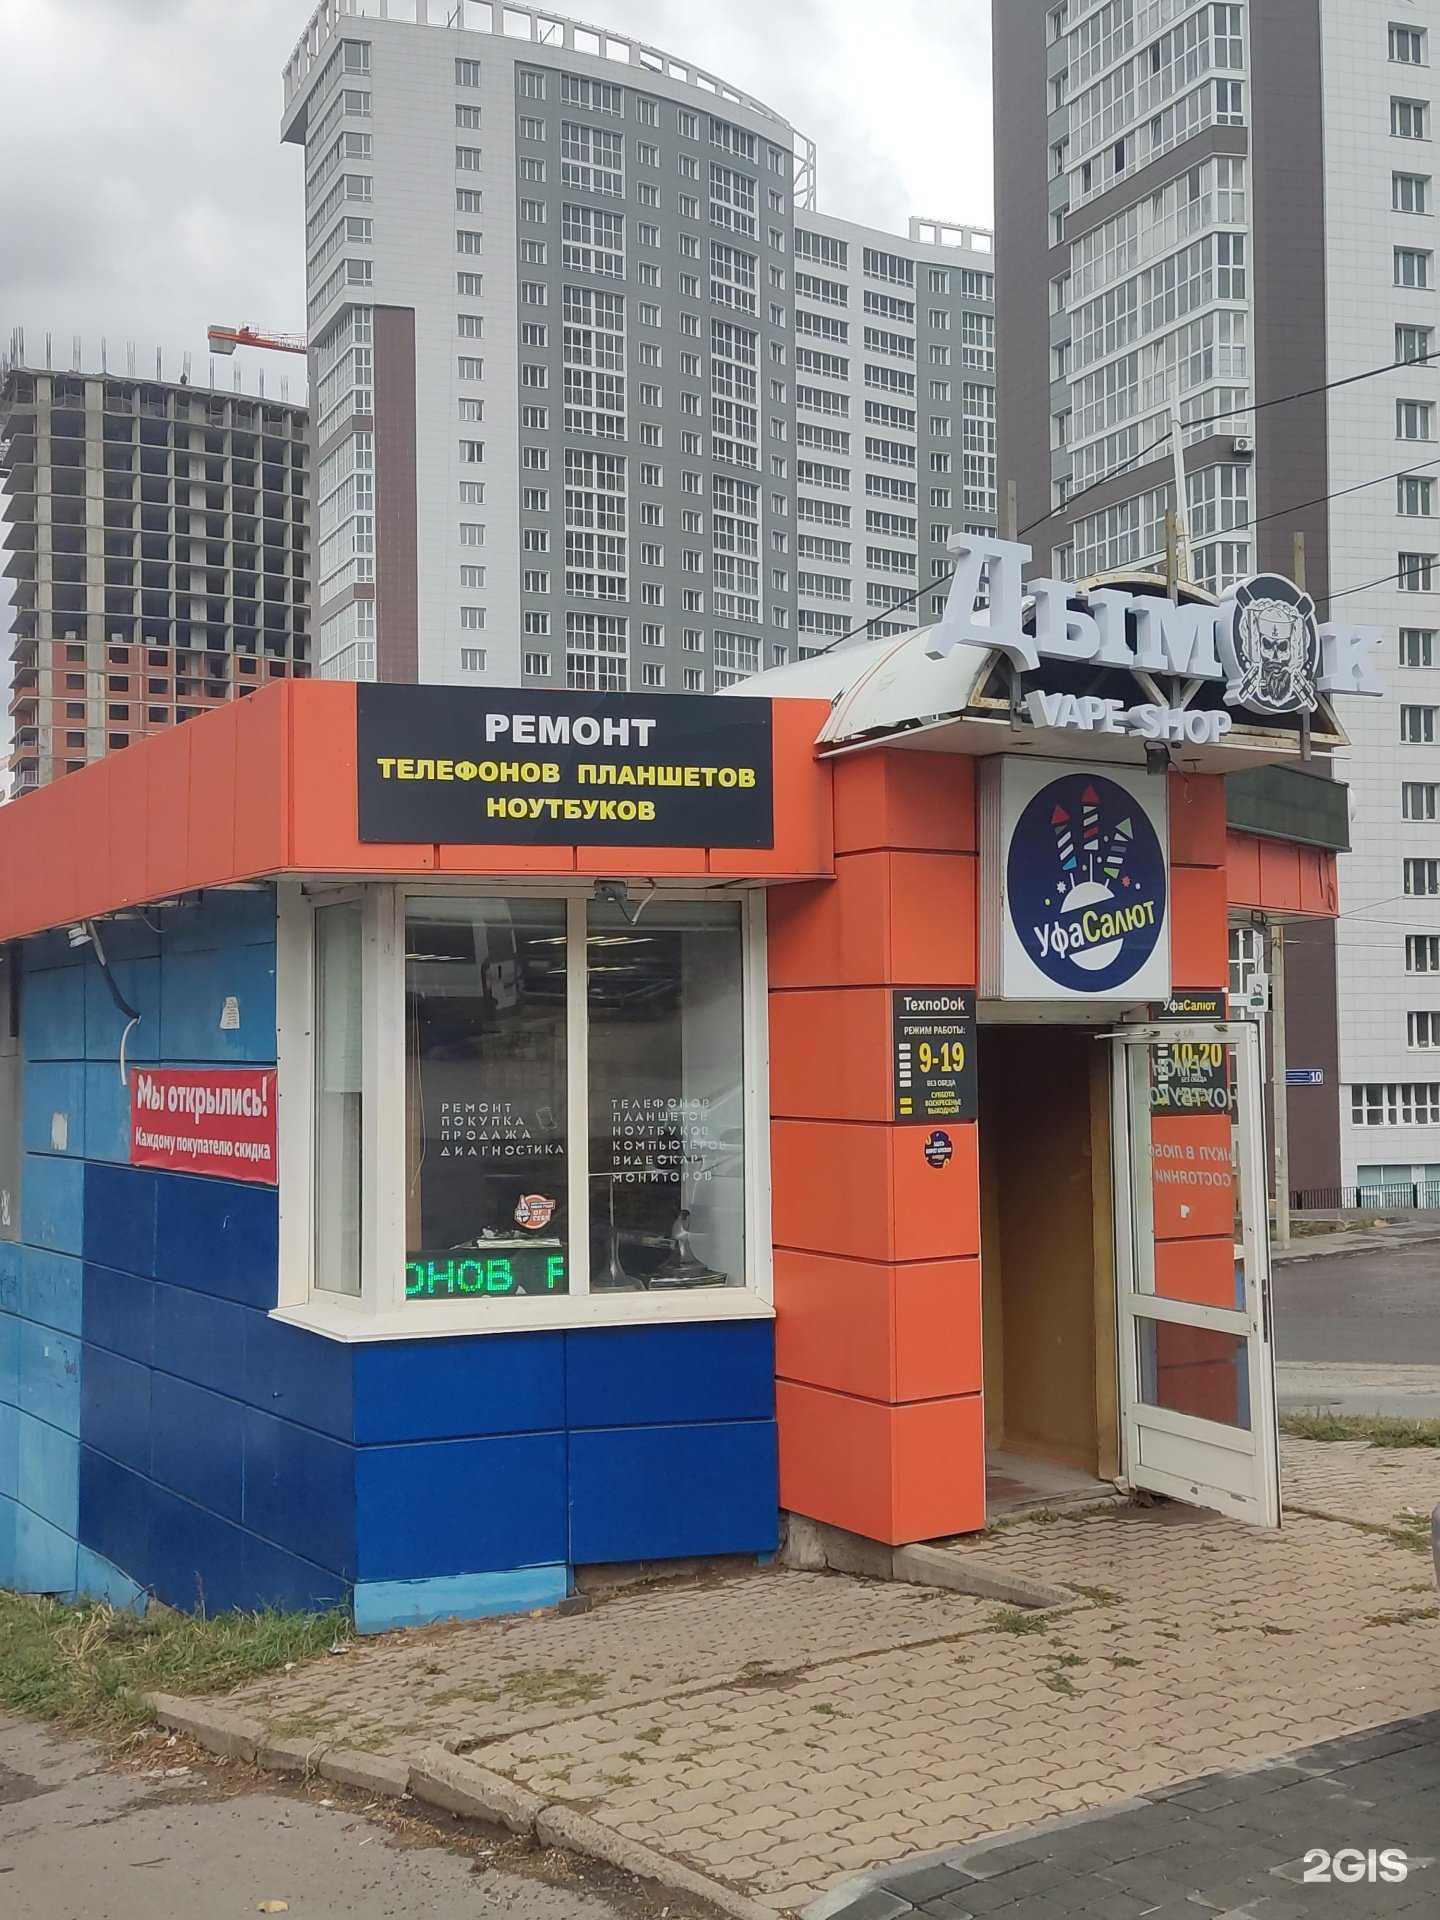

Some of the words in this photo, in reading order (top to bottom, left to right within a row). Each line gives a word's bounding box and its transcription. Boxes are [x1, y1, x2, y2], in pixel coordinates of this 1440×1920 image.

[1024, 690, 1125, 733] VAPE
[1128, 704, 1232, 744] SHOP
[485, 714, 656, 747] РЕМОНТ
[377, 758, 560, 783] ТЕЛЕФОНОВ
[577, 765, 756, 788] ПЛАНШЕТОВ
[487, 798, 656, 820] НОУТБУКОВ
[1033, 901, 1154, 958] УфаСалют
[1163, 999, 1216, 1013] УфаСалют
[904, 1026, 932, 1036] РЕЖИМ
[933, 1025, 966, 1035] РАБОТЫ:
[919, 1042, 965, 1073] 9-19
[137, 1074, 165, 1111] Мы
[167, 1076, 267, 1125] открылись!
[441, 1103, 512, 1113] РЕМОНТ
[441, 1116, 525, 1126] ПОКУПКА
[441, 1129, 532, 1140] ПРОДАЖА
[135, 1126, 175, 1156] Каждому
[176, 1135, 233, 1158] покупателю
[234, 1141, 271, 1162] скидка
[440, 1144, 565, 1156] ДИАГНОСТИКА
[613, 1154, 706, 1165] ВИДЕОКАРТ
[612, 1171, 713, 1183] МОНИТОРОВ
